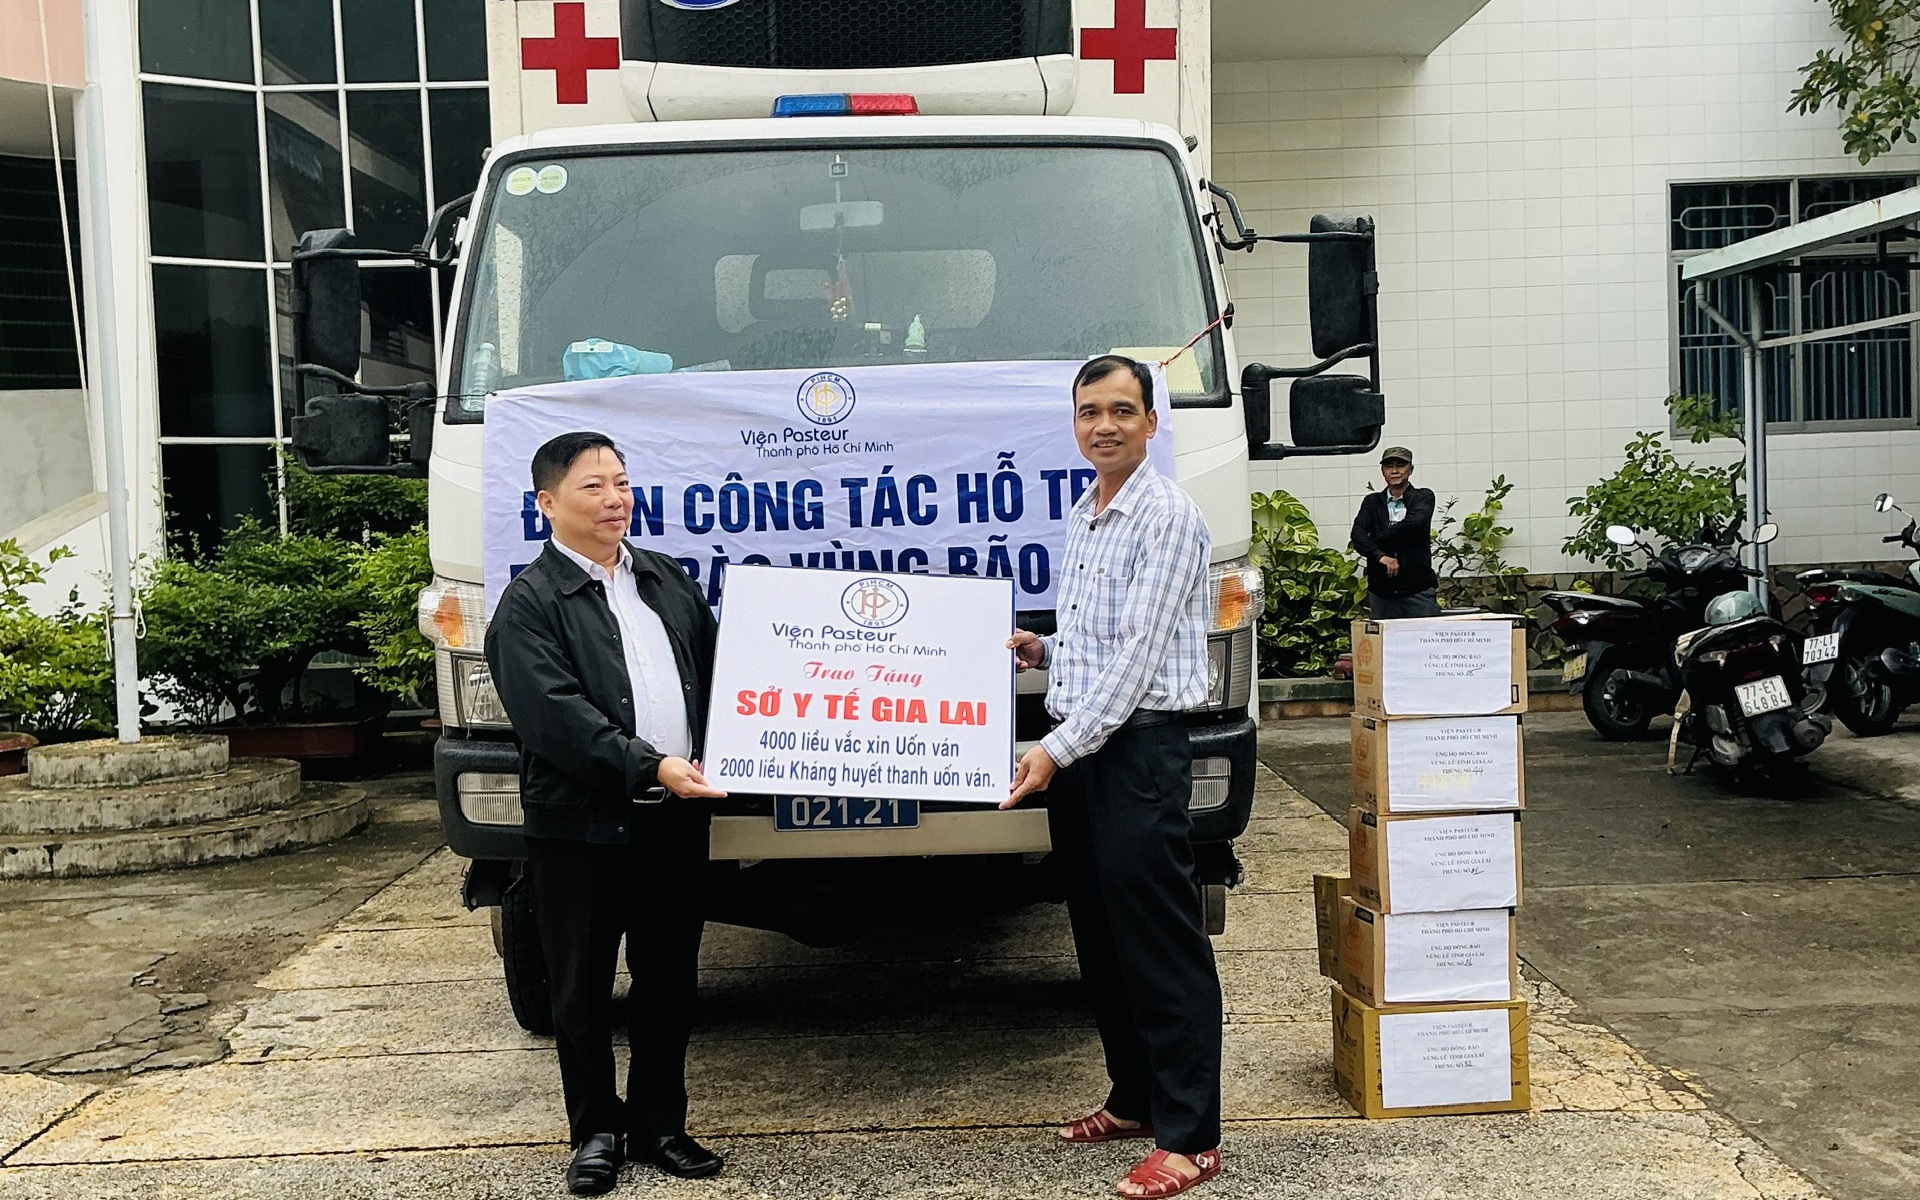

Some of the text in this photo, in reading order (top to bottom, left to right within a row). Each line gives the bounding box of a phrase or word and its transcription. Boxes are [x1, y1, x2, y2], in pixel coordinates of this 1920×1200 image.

[811, 374, 841, 384] PIHCM
[741, 427, 849, 446] Viện Pasteur
[756, 441, 894, 459] Thành phố Hồ Chí Minh
[683, 472, 824, 534] CÔNG
[841, 464, 938, 528] TÁC
[956, 450, 1024, 523] HỖ
[859, 579, 894, 589] PIHCM
[772, 623, 897, 642] Viện Pasteur
[1810, 635, 1833, 649] 77-L1
[788, 639, 947, 656] Thành phố Hồ Chí Minh
[803, 661, 924, 688] Trao Tặng
[1742, 681, 1776, 700] 77-E1
[737, 685, 987, 726] SỞ Y TẾ GIA LAI
[1744, 692, 1787, 714] 648.84
[760, 729, 959, 757] 4000 liều vắc xin Uốn ván
[720, 757, 995, 788] 2000 liều Kháng huyết thanh uốn ván.
[791, 797, 899, 826] 021.21
